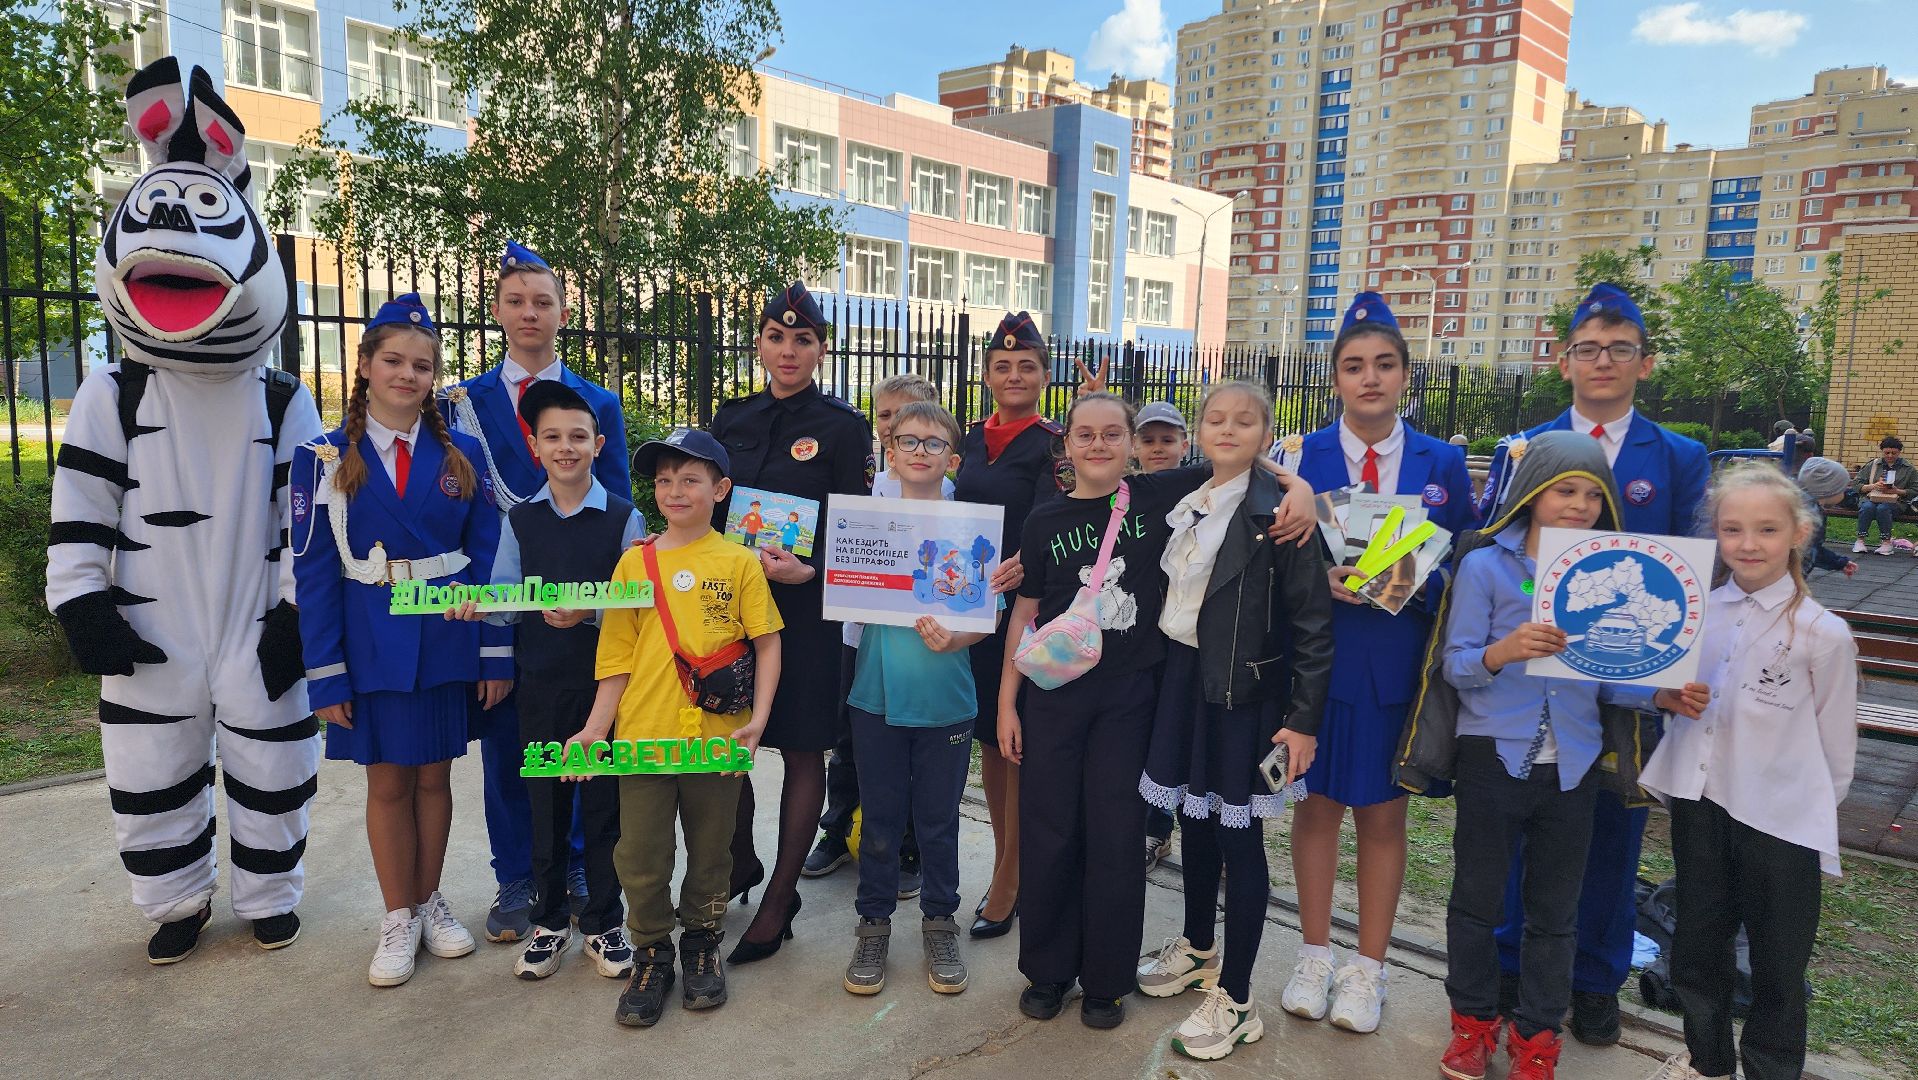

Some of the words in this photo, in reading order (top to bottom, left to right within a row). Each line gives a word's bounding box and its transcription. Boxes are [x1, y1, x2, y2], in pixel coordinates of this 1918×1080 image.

[836, 537, 854, 546] КАК
[856, 538, 889, 548] ЕЗДИТЬ
[1051, 523, 1099, 566] HUG
[835, 546, 848, 554] НА
[850, 547, 909, 559] ВЕЛОСИПЕДЕ
[835, 556, 851, 564] БЕЗ
[852, 556, 896, 567] ШТРАФОВ
[701, 581, 727, 592] FAST
[1541, 539, 1699, 636] ГОСАВТОИНСПЕКЦИЯ
[1563, 650, 1622, 674] СКОВСКОЙ
[523, 737, 752, 770] #ЗАСВЕТИСЬ
